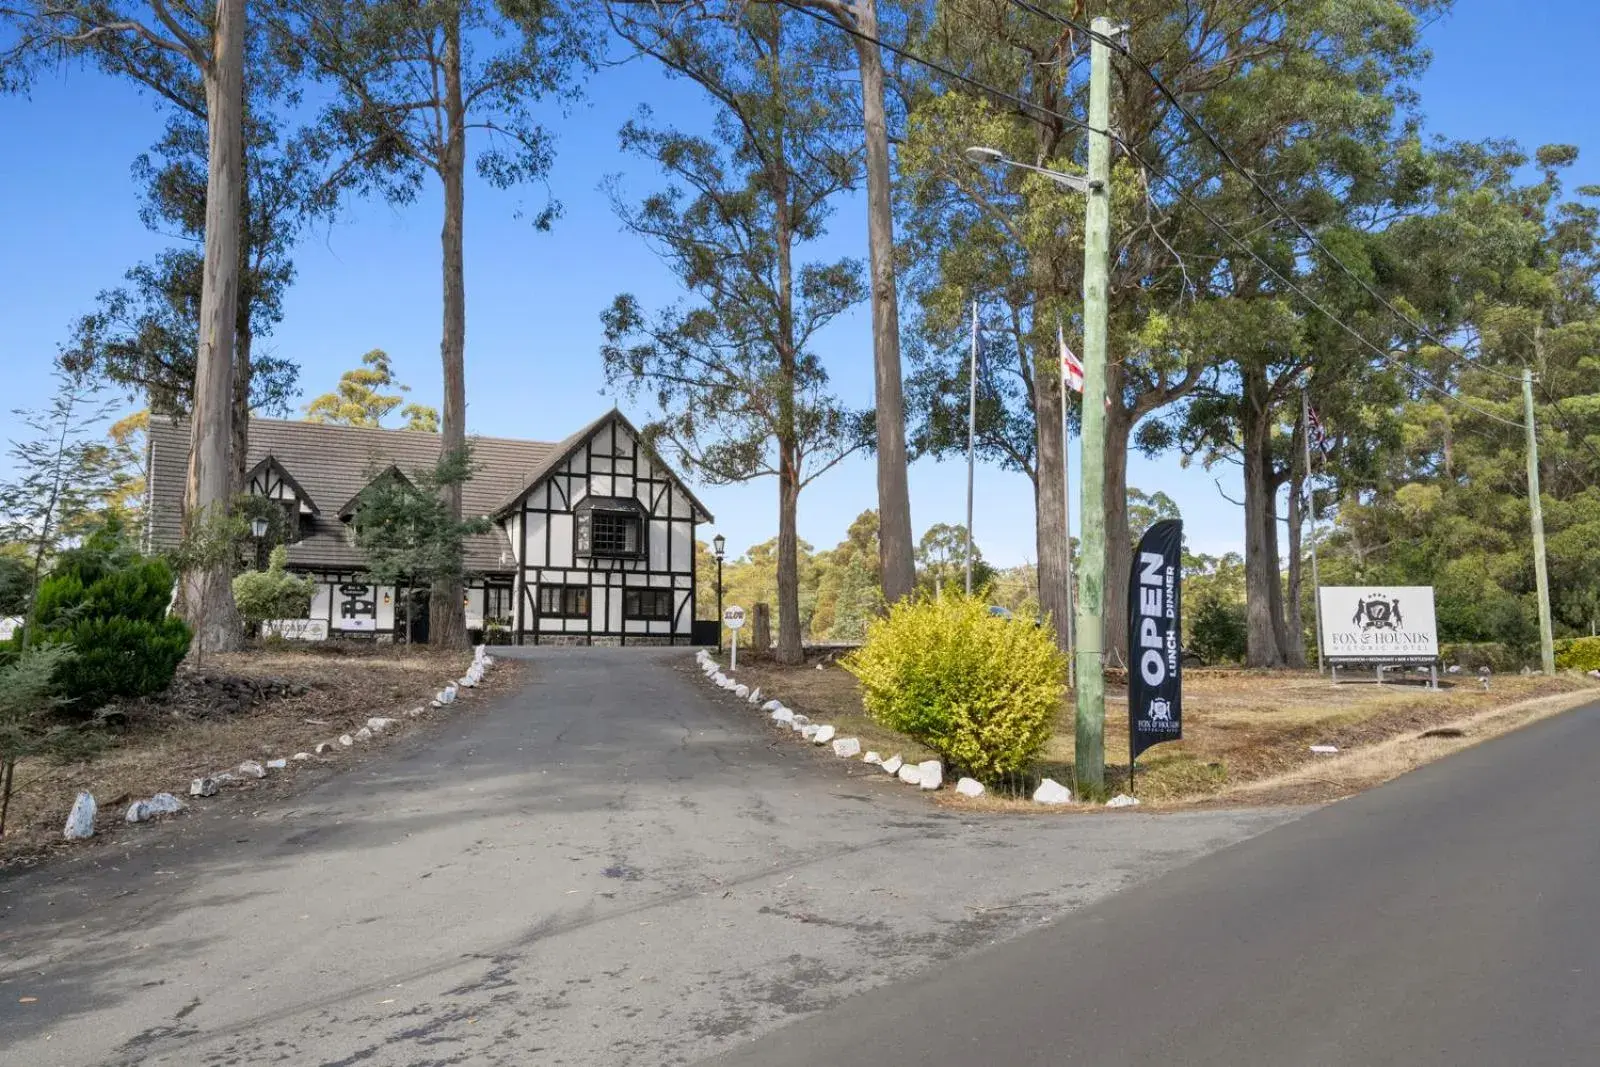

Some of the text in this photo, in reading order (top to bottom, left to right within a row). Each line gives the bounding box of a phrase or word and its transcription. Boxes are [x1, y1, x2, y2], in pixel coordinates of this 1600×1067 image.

[724, 611, 744, 620] SLOW
[1140, 551, 1165, 687] OPEN
[1166, 565, 1177, 678] LUNCH DINNER
[1332, 632, 1430, 644] FOX & HOUNDS
